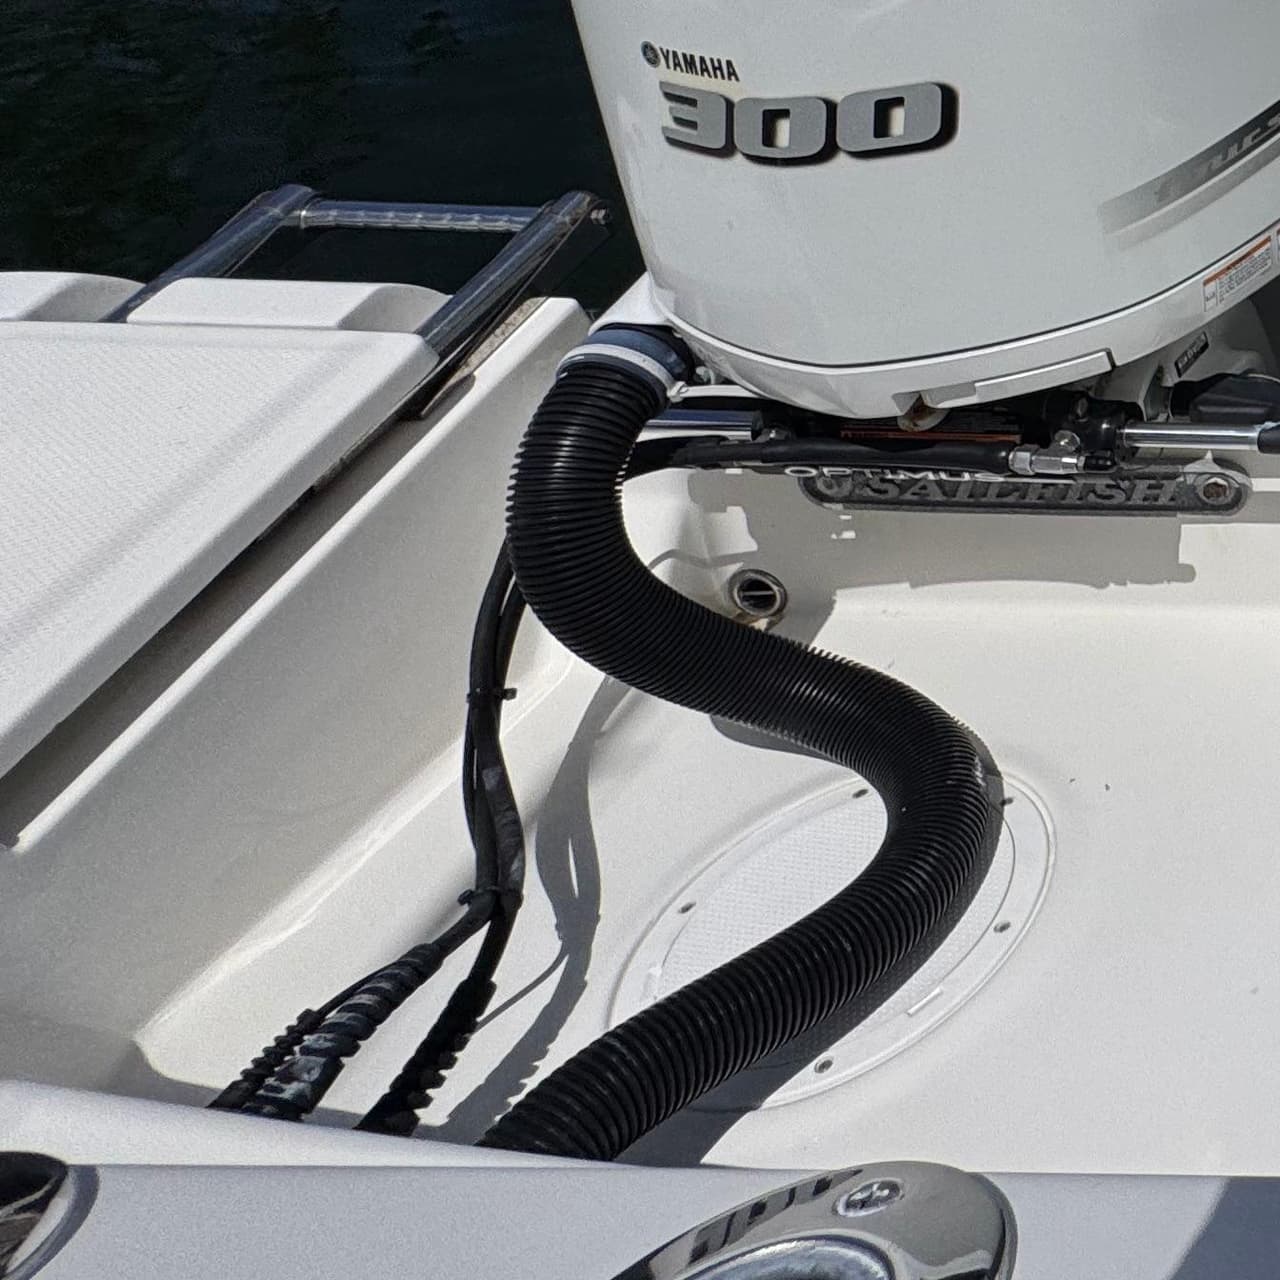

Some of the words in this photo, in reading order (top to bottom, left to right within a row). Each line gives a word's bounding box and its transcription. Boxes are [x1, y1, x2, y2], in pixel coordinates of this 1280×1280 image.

[659, 46, 741, 83] YAMAHA
[660, 80, 959, 166] 300
[784, 465, 1005, 482] OPTIMUS
[861, 474, 1186, 506] SAILFISH
